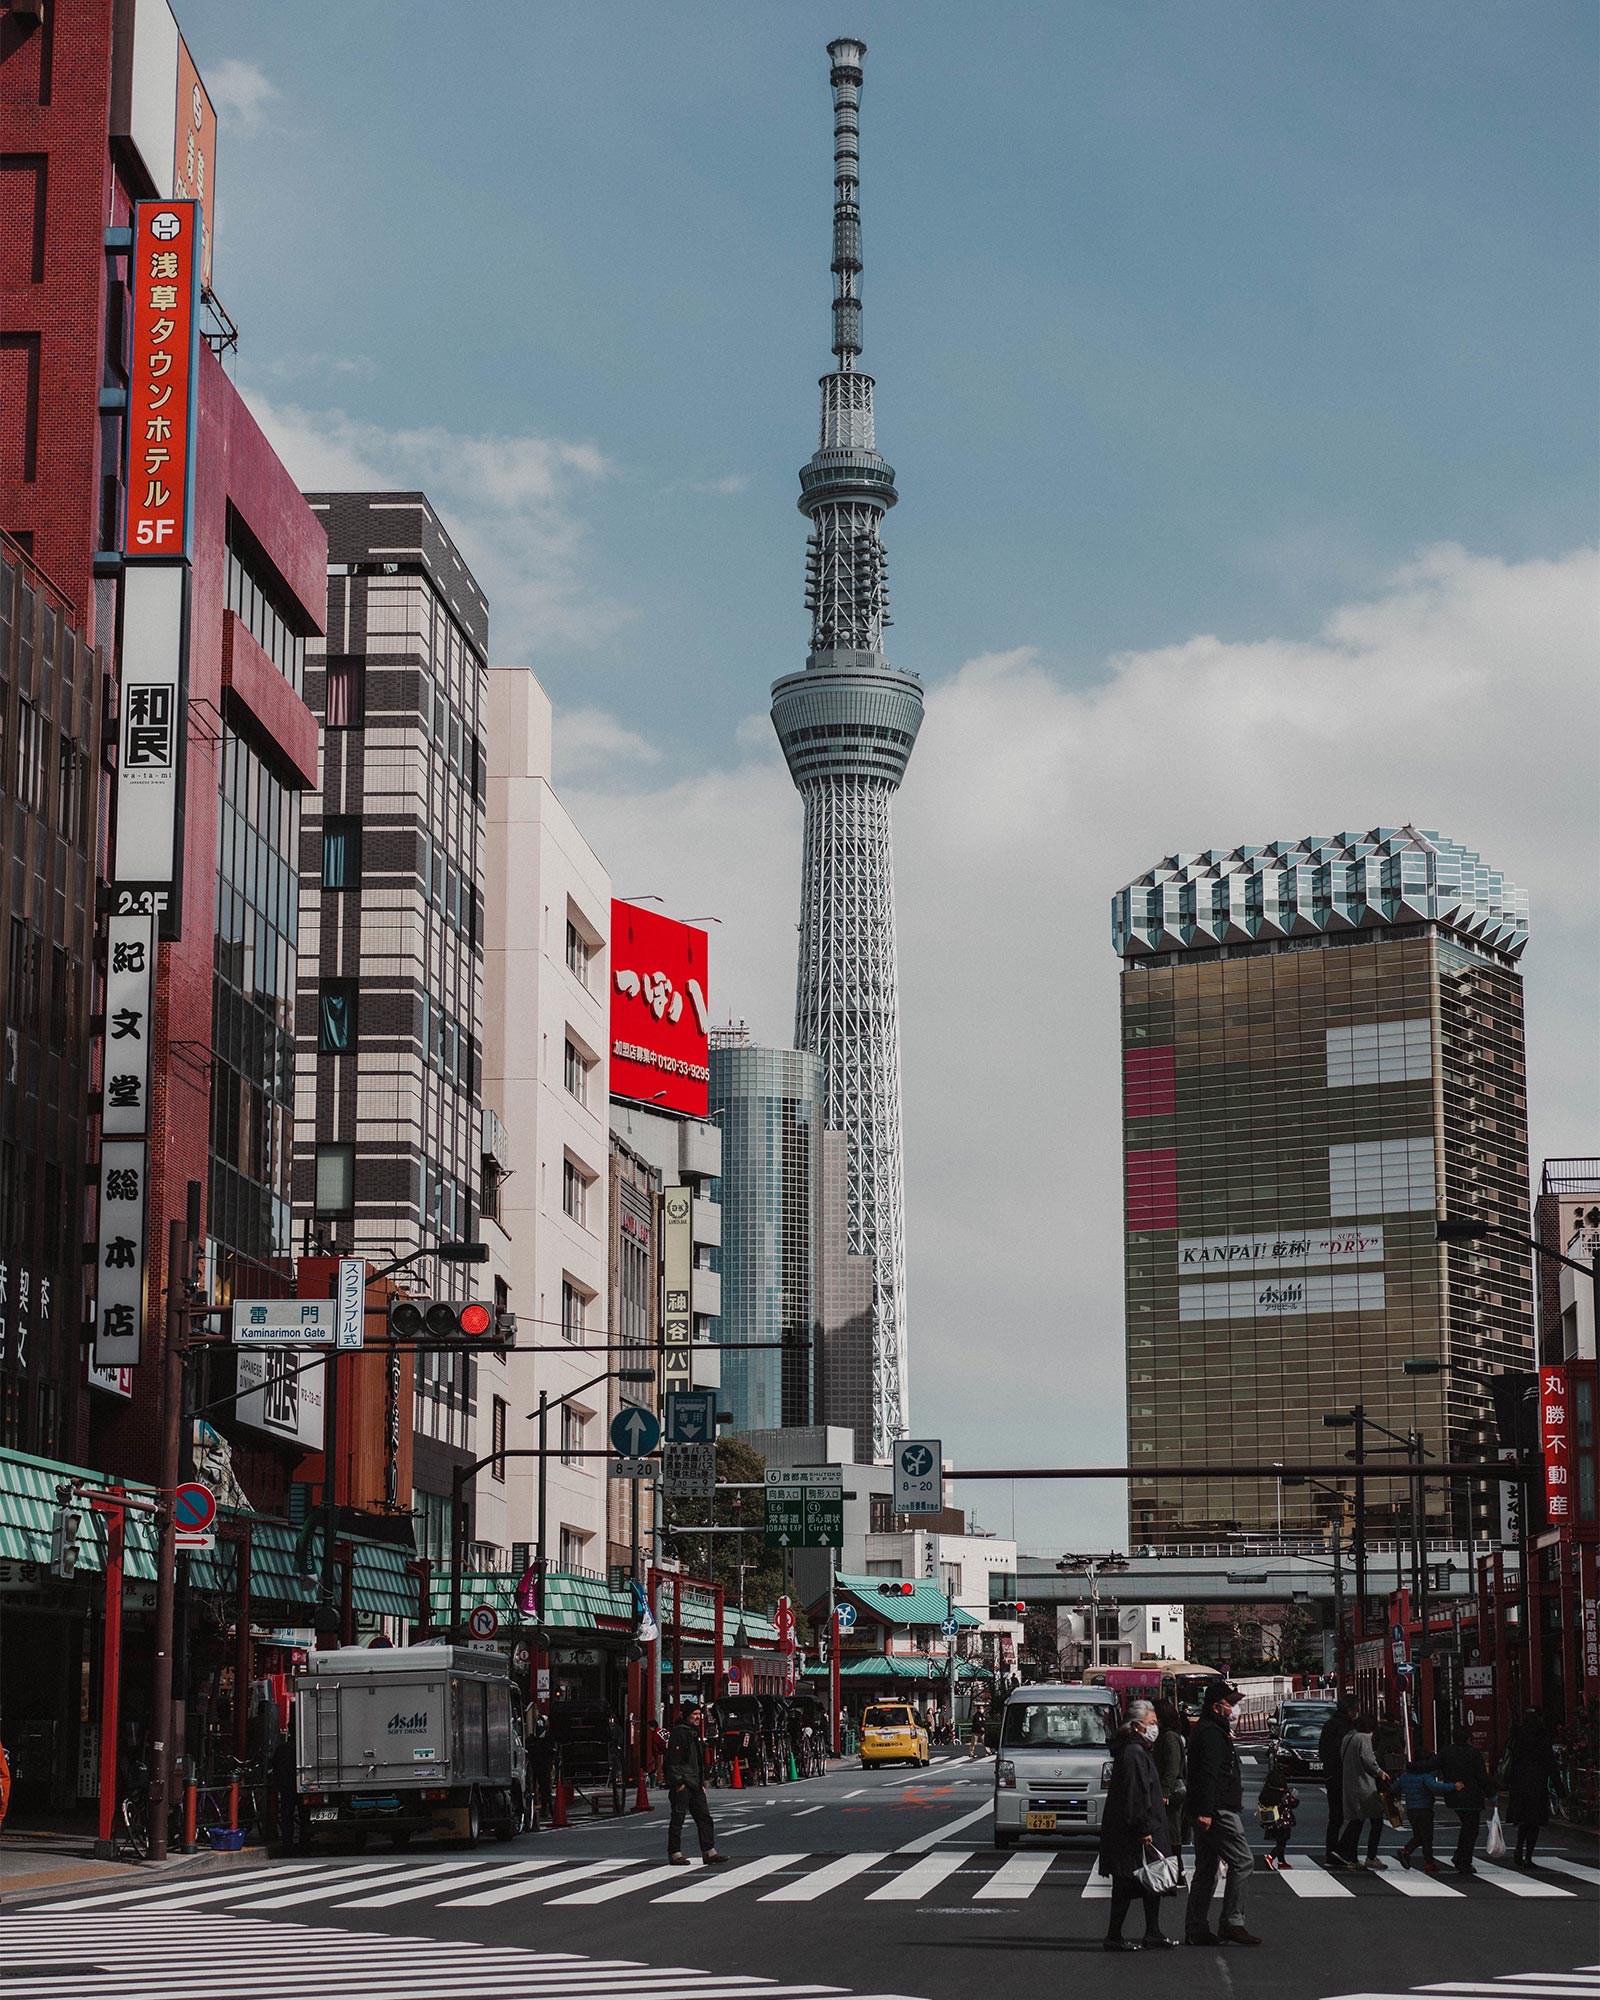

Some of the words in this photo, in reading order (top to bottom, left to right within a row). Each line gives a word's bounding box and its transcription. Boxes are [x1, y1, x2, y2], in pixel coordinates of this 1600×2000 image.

[142, 251, 178, 509] 浅草タウンホテル
[136, 519, 175, 545] 5F
[129, 688, 169, 764] 和民
[108, 941, 145, 1108] 紀文堂
[657, 1054, 710, 1082] 0120-33-9295
[103, 1168, 139, 1338] 総本店
[343, 1263, 359, 1345] スクランブル式
[1259, 1282, 1303, 1304] Asahi
[1265, 1303, 1297, 1311] アサヒビール
[241, 1327, 301, 1338] Kaminarimon
[304, 1327, 326, 1338] Gate
[1544, 1375, 1569, 1516] 丸勝不動産
[770, 1472, 777, 1481] 6
[782, 1472, 808, 1482] 首都高
[769, 1489, 799, 1499] 向島入口
[766, 1524, 788, 1532] JOBAN
[769, 1514, 800, 1524] 常磐道
[808, 1524, 832, 1532] Circle
[925, 1541, 934, 1578] 水上バ
[388, 1712, 427, 1729] Asahi
